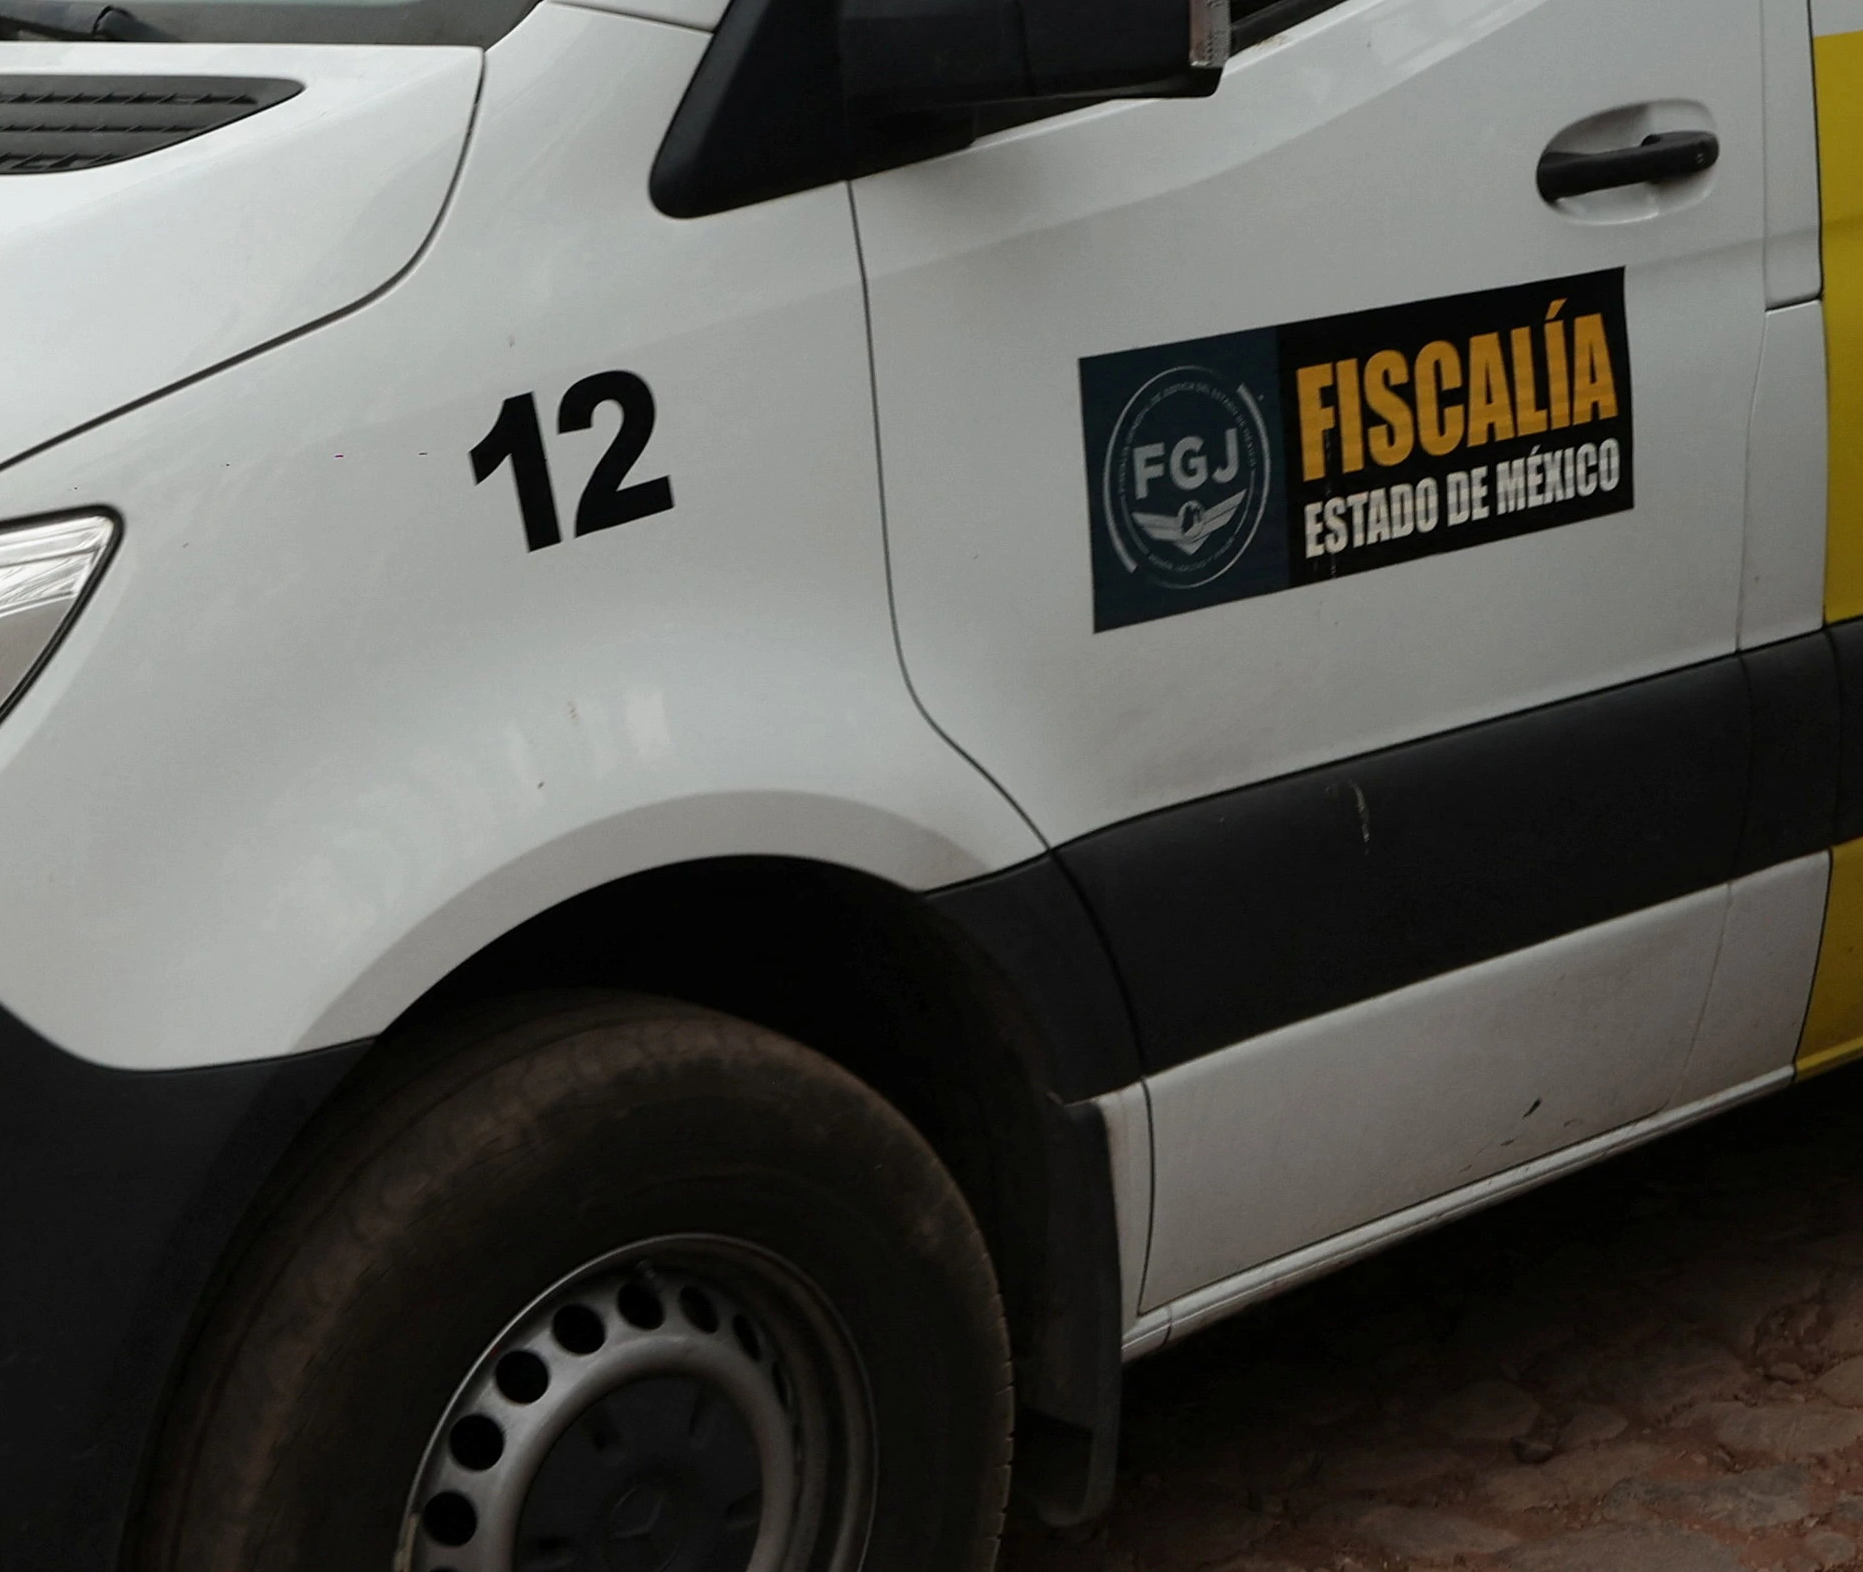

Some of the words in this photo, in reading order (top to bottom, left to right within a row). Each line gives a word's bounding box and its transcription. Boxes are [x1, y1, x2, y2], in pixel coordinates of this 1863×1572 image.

[468, 369, 675, 553] 12
[1132, 427, 1239, 501] FGJ
[1296, 297, 1618, 482] FISCALÍA
[1304, 477, 1438, 559] ESTADO
[1446, 464, 1488, 527] DE
[1496, 438, 1620, 515] MÉXICO
